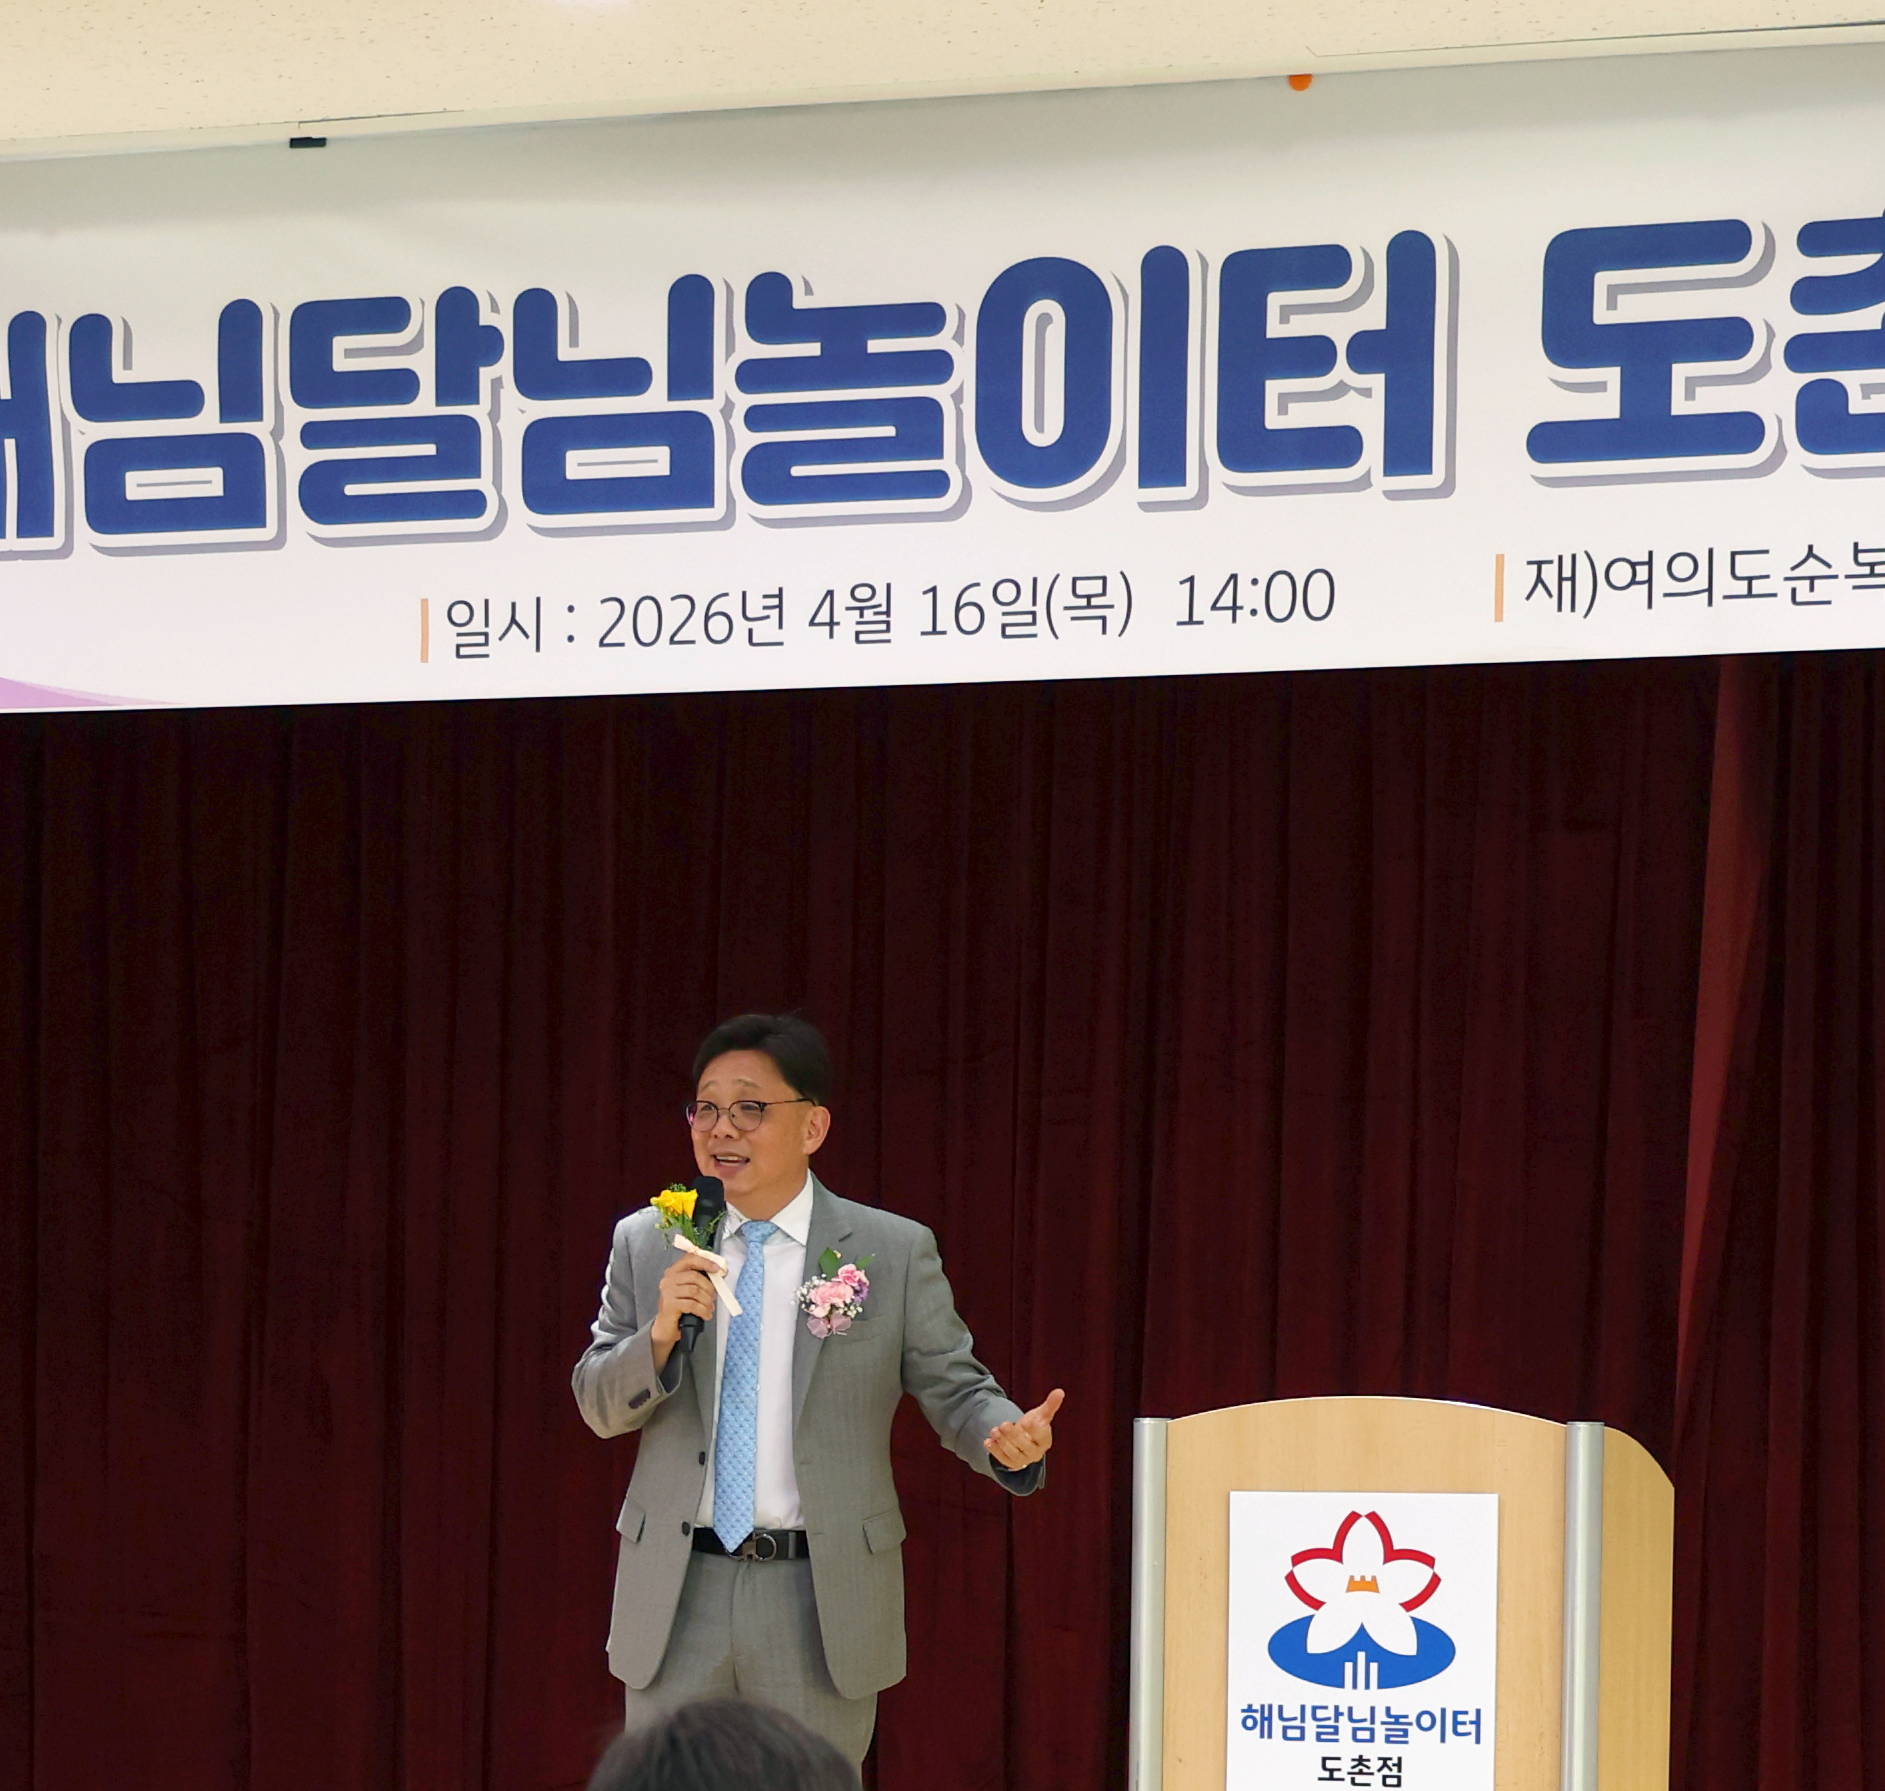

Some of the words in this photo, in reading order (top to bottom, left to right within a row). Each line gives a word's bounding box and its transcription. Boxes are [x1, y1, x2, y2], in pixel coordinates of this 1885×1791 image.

[446, 596, 541, 659] 일시
[598, 586, 784, 648] 2026년
[808, 582, 892, 645] 4월
[920, 570, 1134, 640] 16일(목)
[1176, 568, 1335, 626] 14:00
[1240, 1703, 1482, 1745] 해님달님놀이터
[1317, 1754, 1404, 1788] 도촌점
